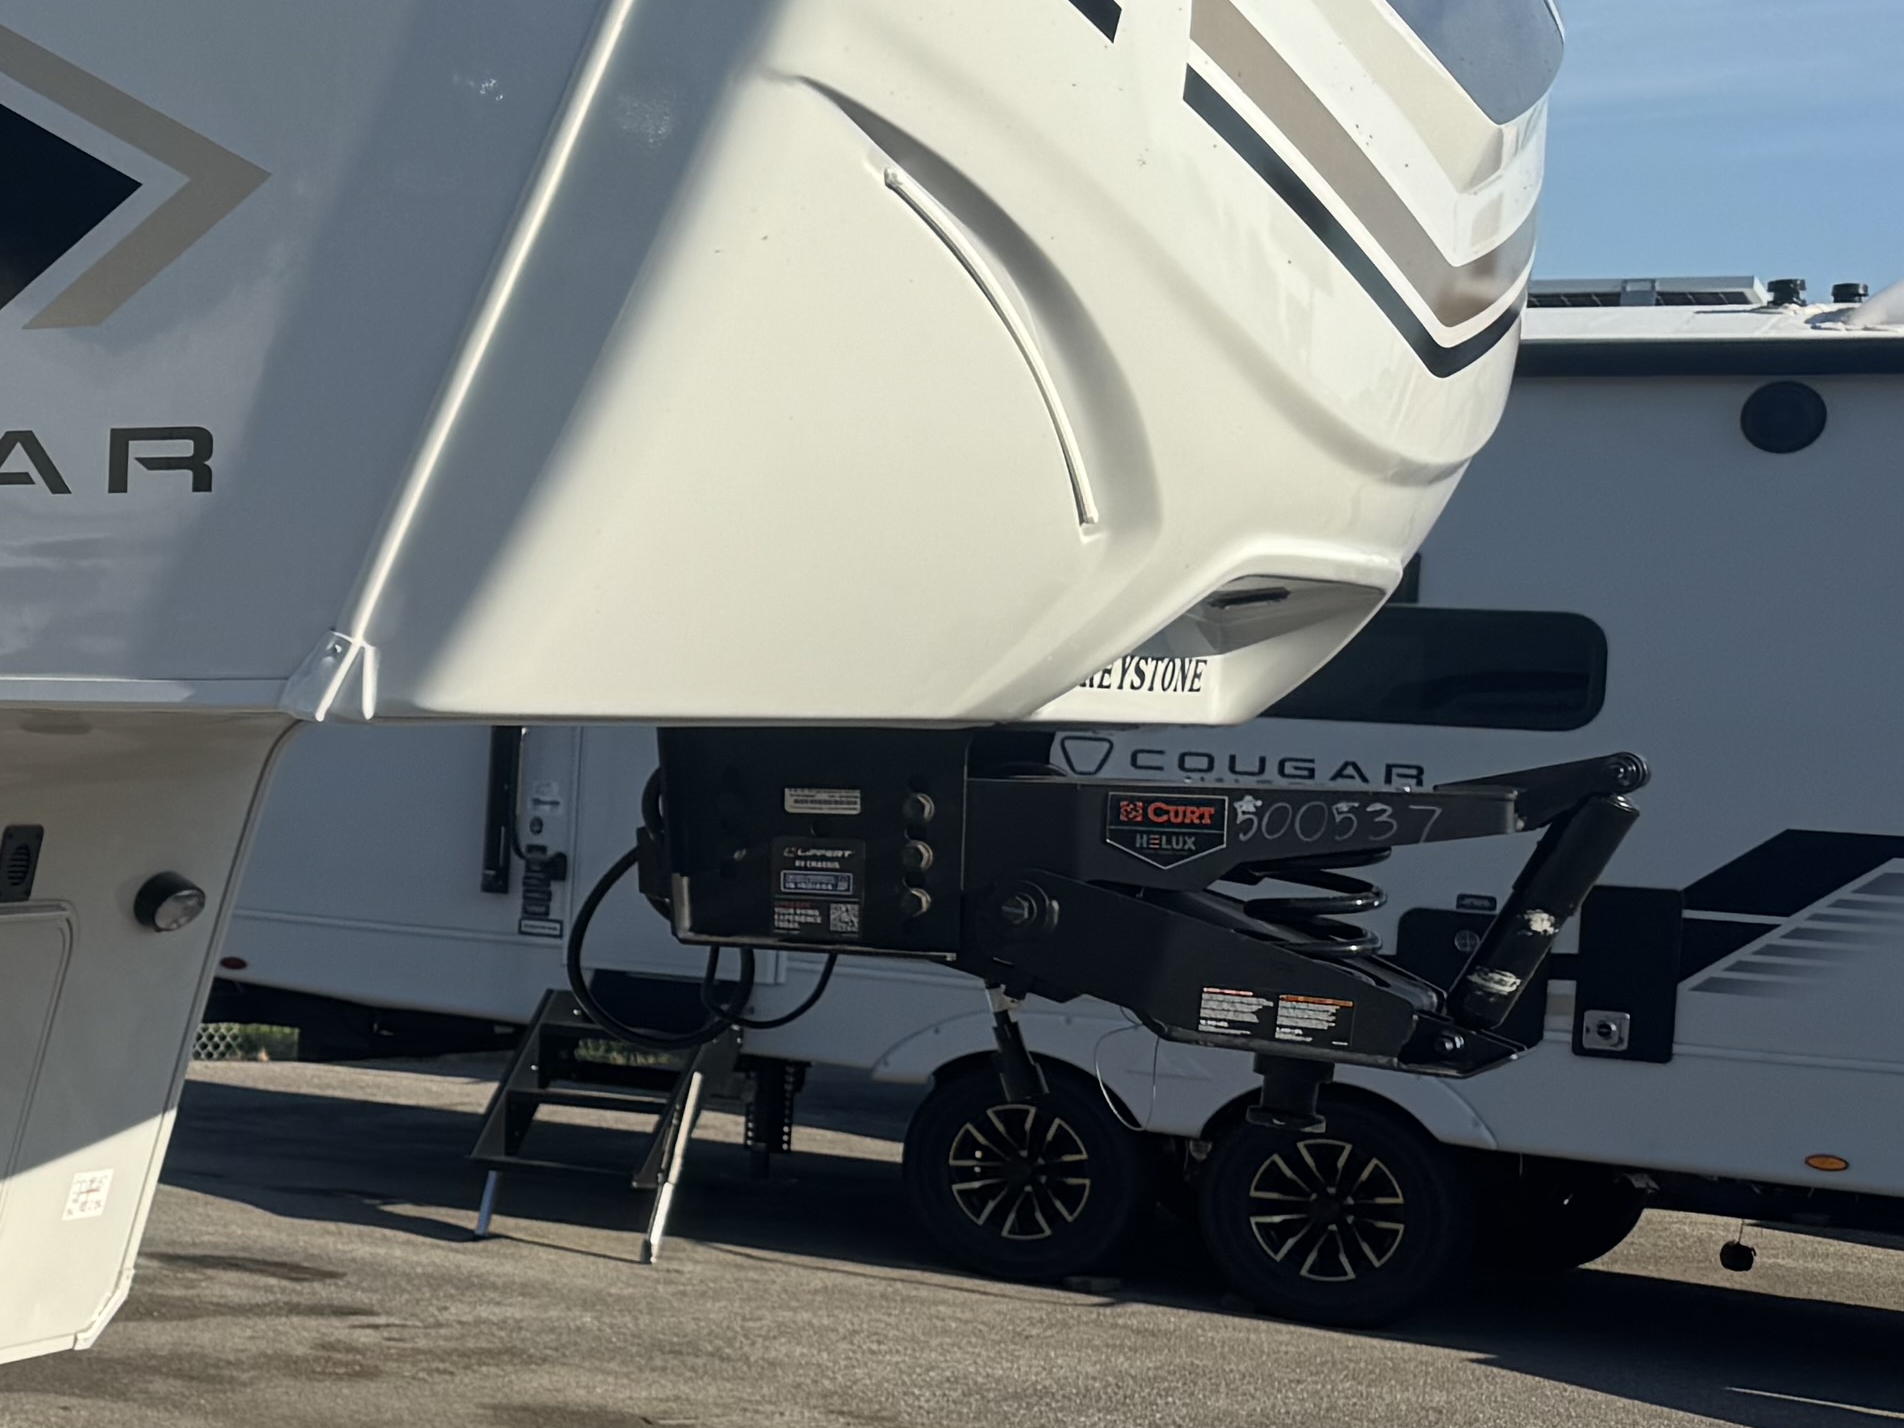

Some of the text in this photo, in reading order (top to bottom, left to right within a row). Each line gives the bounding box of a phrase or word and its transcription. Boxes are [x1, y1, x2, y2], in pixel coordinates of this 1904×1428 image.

[1079, 655, 1208, 692] EYSTONE
[1130, 749, 1426, 786] COUGAR
[1147, 803, 1216, 825] CURT
[1233, 795, 1443, 844] 500537
[1135, 833, 1197, 851] HELUX
